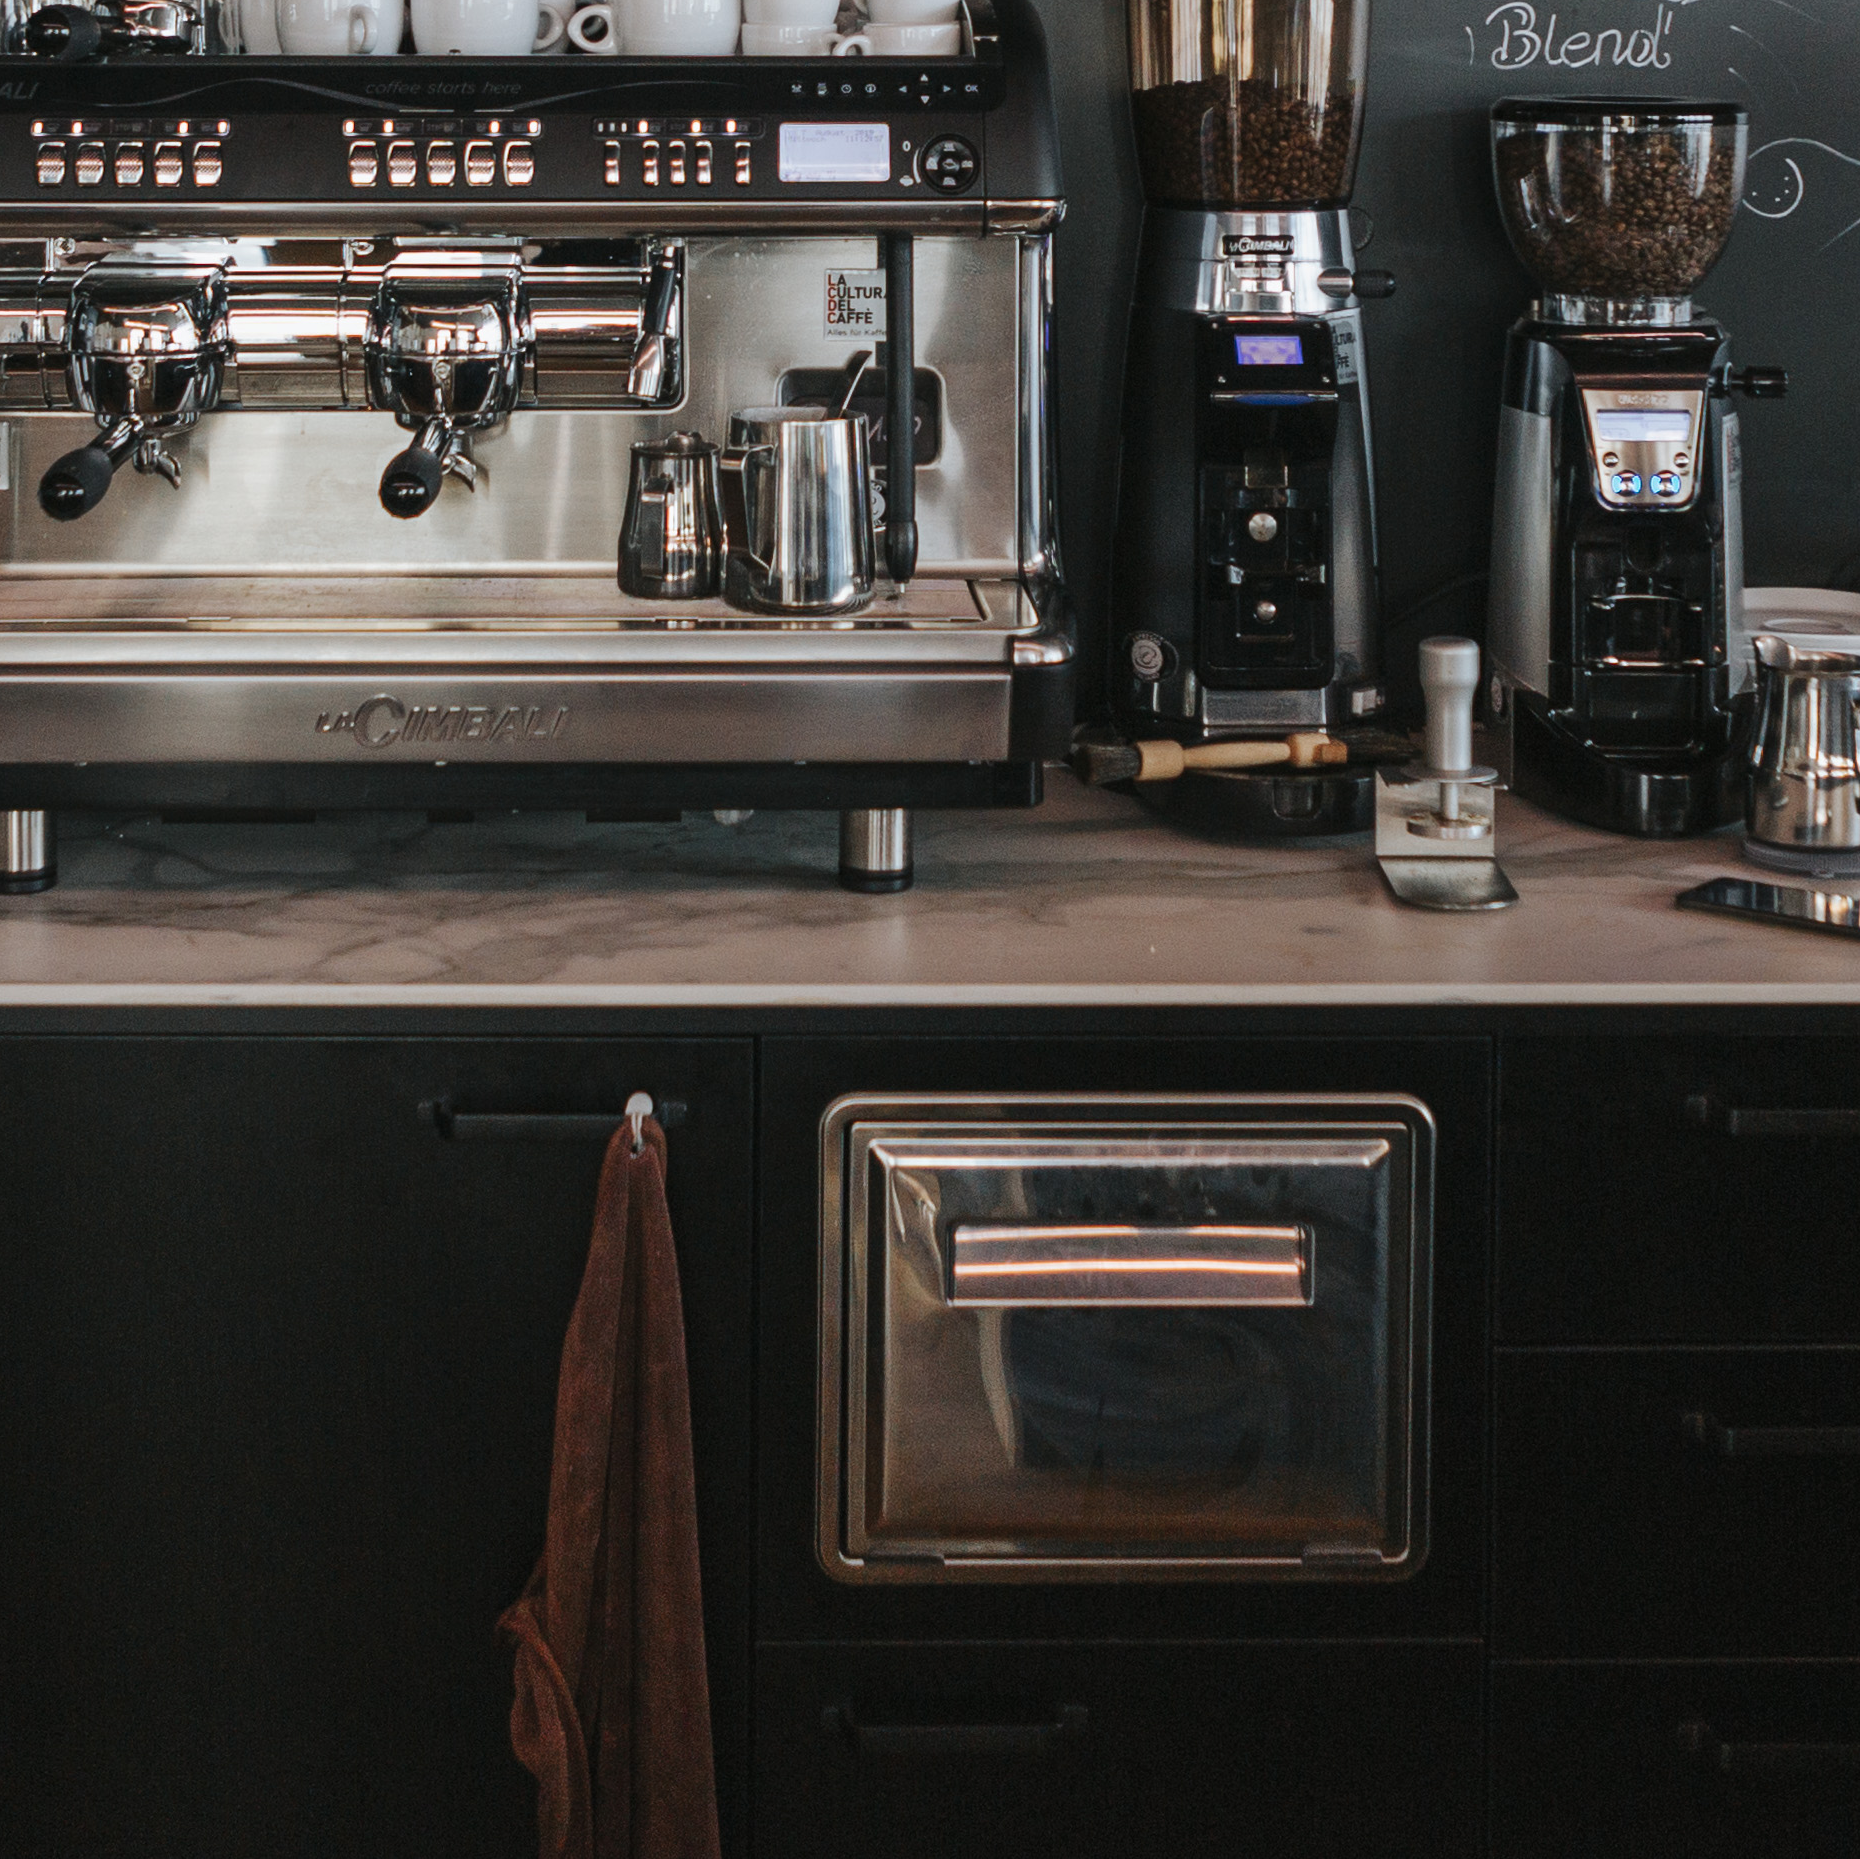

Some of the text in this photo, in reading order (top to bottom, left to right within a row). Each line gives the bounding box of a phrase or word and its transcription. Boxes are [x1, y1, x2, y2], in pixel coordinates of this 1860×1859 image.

[1485, 2, 1673, 71] Blend
[964, 83, 979, 93] OK
[828, 274, 847, 287] LA
[828, 286, 887, 299] CULTUR
[828, 299, 856, 312] DEL
[827, 307, 874, 324] CAFFÈ
